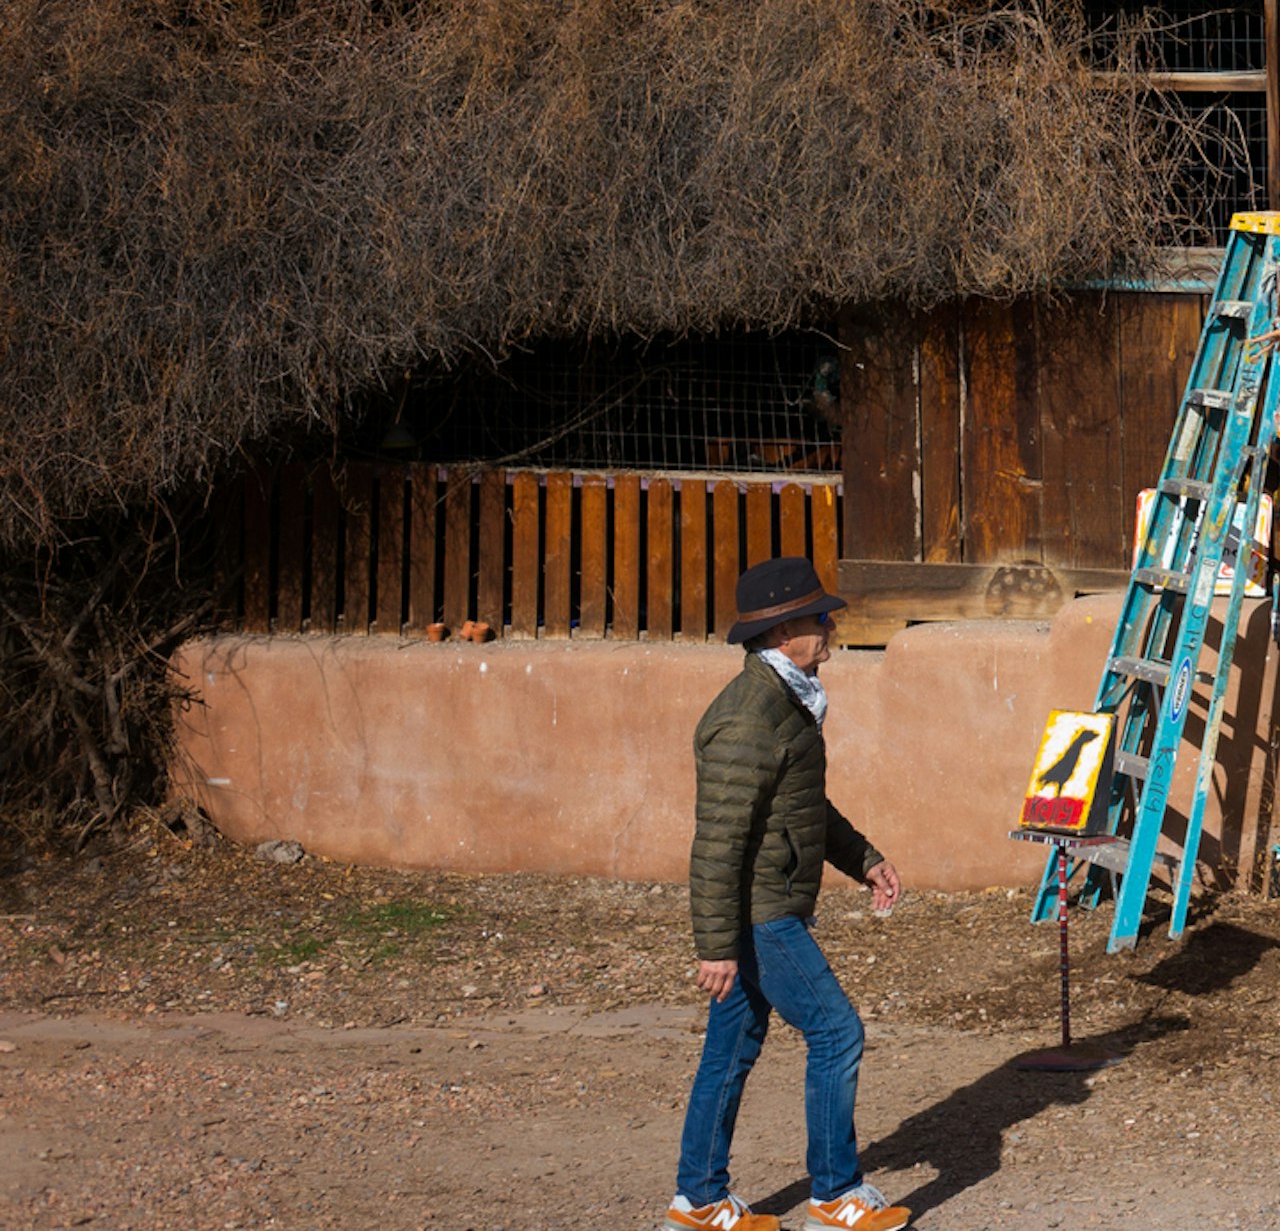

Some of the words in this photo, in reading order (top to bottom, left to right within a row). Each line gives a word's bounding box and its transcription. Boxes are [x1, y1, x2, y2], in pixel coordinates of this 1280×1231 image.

[1150, 746, 1177, 813] Kelly
[1029, 798, 1074, 824] Kelly
[711, 1208, 740, 1231] N
[837, 1204, 864, 1227] N
